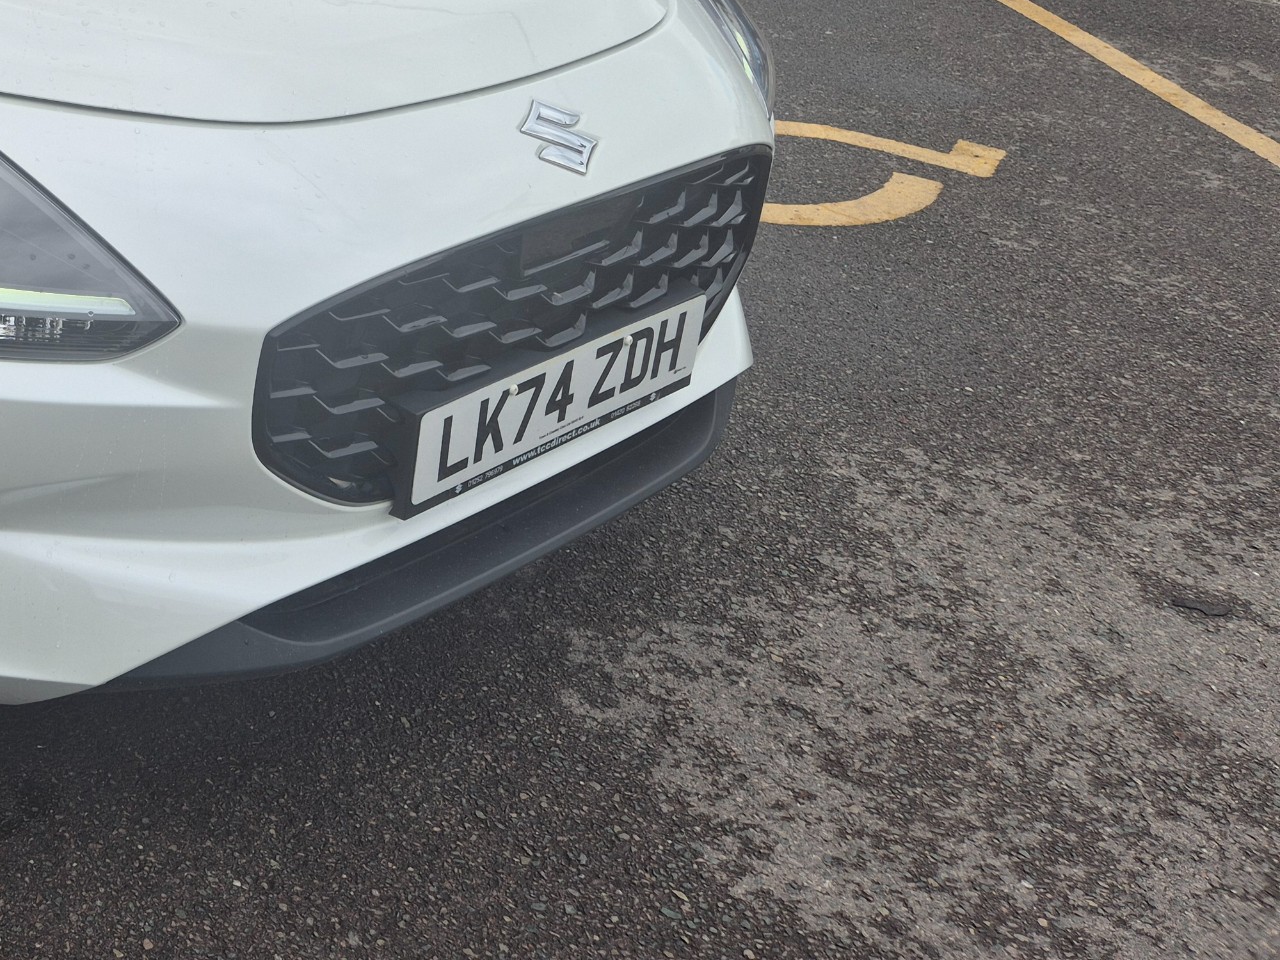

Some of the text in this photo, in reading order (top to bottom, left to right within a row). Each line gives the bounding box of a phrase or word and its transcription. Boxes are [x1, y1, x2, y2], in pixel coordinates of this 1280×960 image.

[437, 311, 687, 482] LK74 ZDH
[512, 418, 601, 466] www.tccdirect.co.uk
